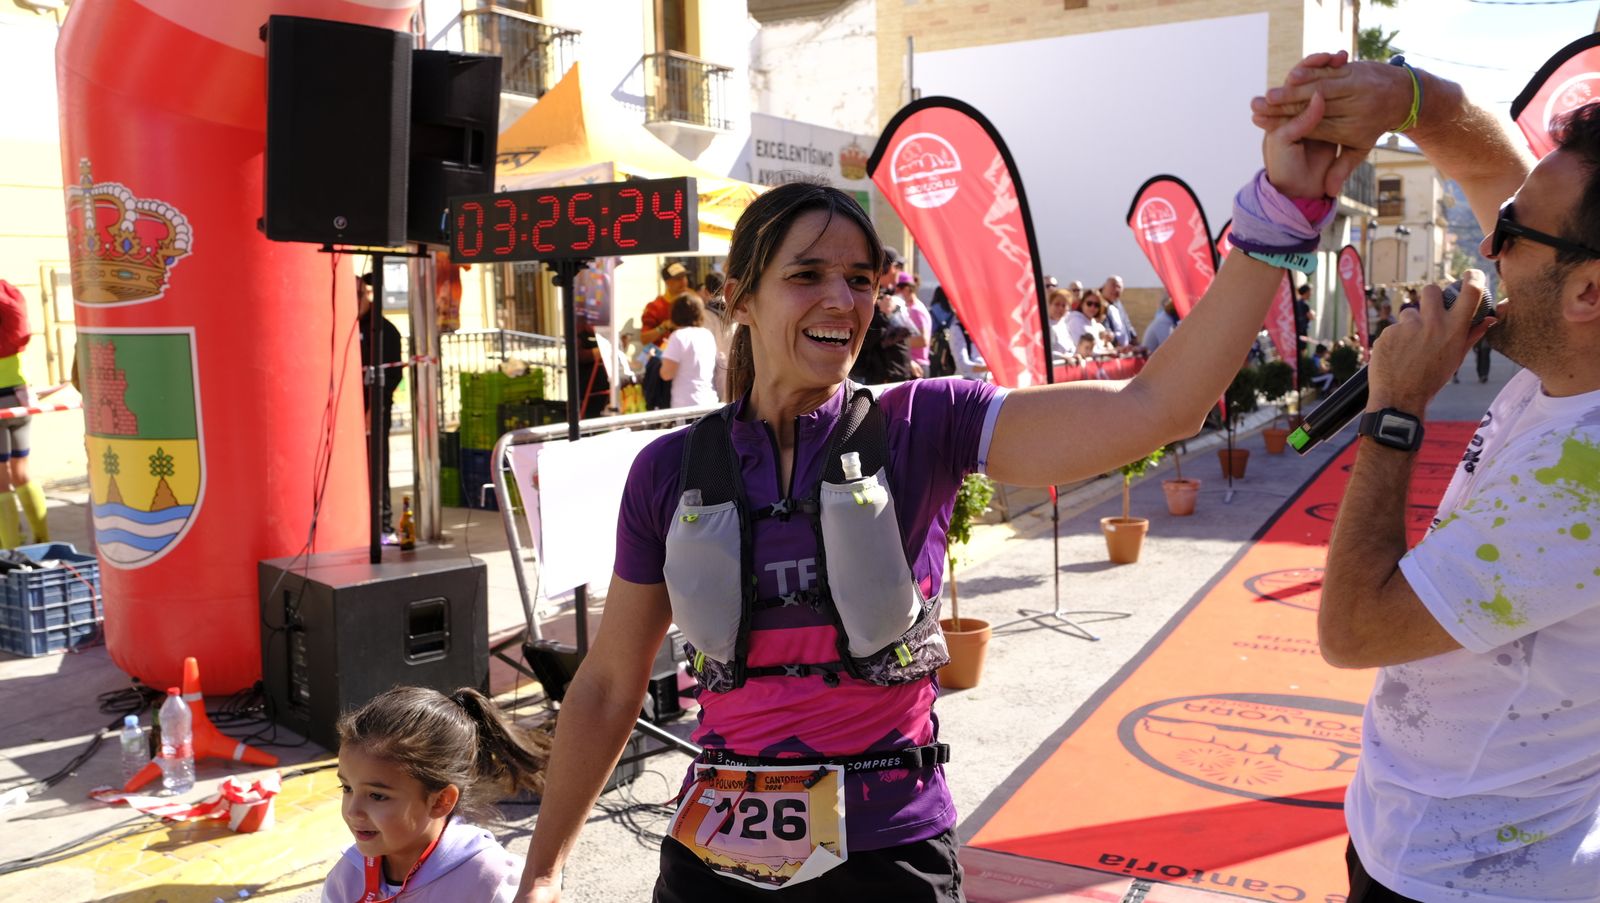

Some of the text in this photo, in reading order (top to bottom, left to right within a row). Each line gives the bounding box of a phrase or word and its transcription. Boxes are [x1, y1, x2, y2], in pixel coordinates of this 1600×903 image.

[756, 139, 834, 168] EXCELENTÍSIMO
[457, 189, 683, 257] 03:25:24
[715, 797, 808, 841] 126
[1097, 852, 1306, 901] Cantoria
